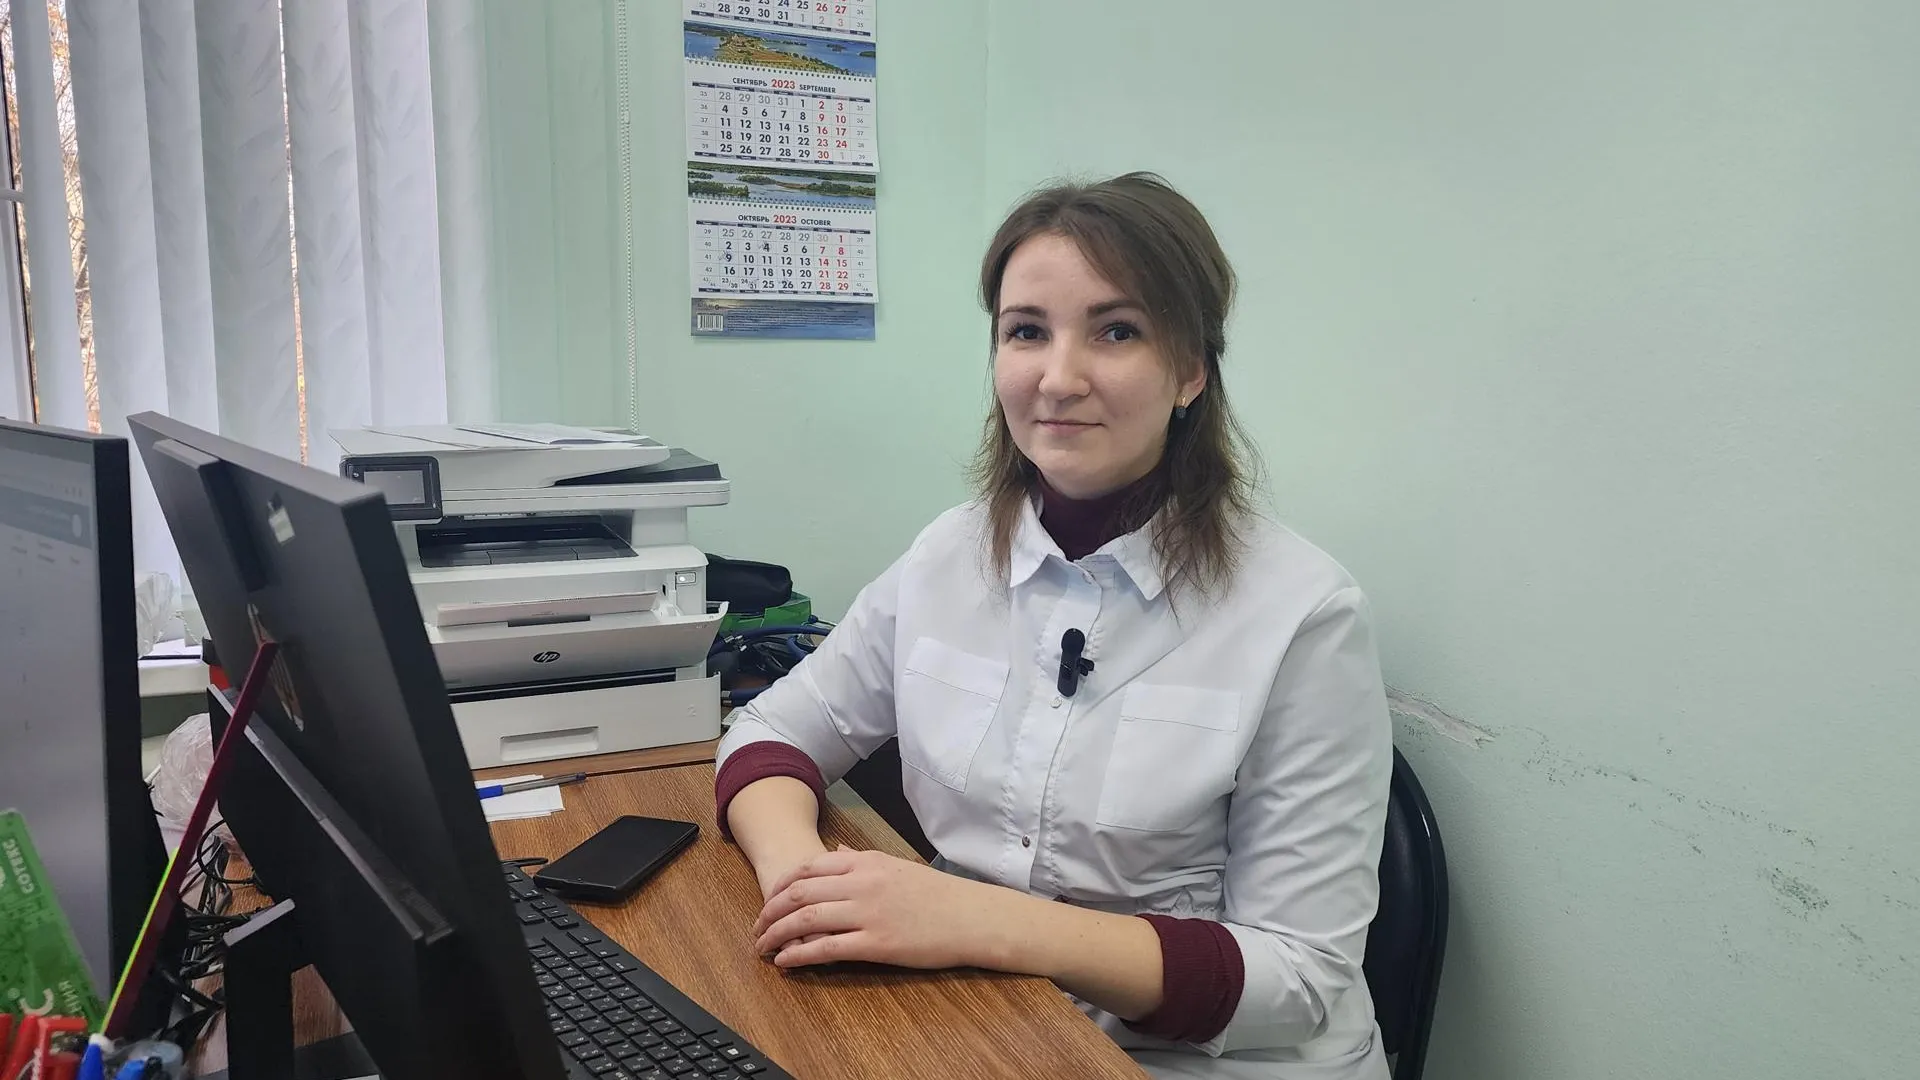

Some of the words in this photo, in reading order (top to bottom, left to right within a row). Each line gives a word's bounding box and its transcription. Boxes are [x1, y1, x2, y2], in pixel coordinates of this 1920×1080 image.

[797, 1, 809, 9] 25
[816, 3, 828, 12] 26
[835, 5, 847, 14] 27
[718, 3, 730, 13] 28
[738, 6, 750, 15] 29
[758, 8, 770, 18] 30
[778, 11, 789, 20] 31
[801, 13, 805, 22] 1
[819, 16, 825, 25] 2
[838, 18, 843, 27] 3
[733, 77, 767, 87] СЕНТЯБРЬ
[771, 79, 796, 89] 2023
[799, 83, 836, 93] SEPTEMBER
[719, 91, 731, 100] 28
[738, 93, 751, 103] 29
[758, 95, 770, 104] 30
[778, 96, 789, 106] 31
[800, 99, 805, 107] 1
[819, 101, 825, 109] 2
[837, 102, 843, 111] 3
[722, 105, 729, 113] 4
[742, 107, 748, 115] 5
[761, 108, 768, 117] 6
[781, 110, 787, 119] 7
[800, 111, 806, 120] 8
[819, 114, 825, 122] 9
[836, 115, 846, 124] 10
[720, 117, 731, 126] 11
[740, 119, 751, 128] 12
[759, 121, 771, 130] 13
[779, 123, 790, 131] 14
[798, 124, 809, 133] 15
[817, 126, 828, 135] 16
[836, 127, 847, 136] 17
[720, 130, 732, 140] 18
[740, 132, 752, 141] 19
[759, 134, 771, 143] 20
[778, 136, 790, 144] 21
[798, 137, 810, 146] 22
[817, 139, 829, 147] 23
[836, 140, 847, 148] 24
[720, 144, 733, 153] 25
[740, 145, 752, 154] 26
[759, 147, 771, 156] 27
[779, 148, 791, 157] 28
[798, 149, 810, 158] 29
[817, 151, 829, 159] 30
[840, 152, 844, 160] 1
[738, 215, 770, 223] ОКТЯБРЬ
[773, 215, 797, 224] 2023
[800, 218, 831, 226] OCTOBER
[722, 229, 734, 237] 25
[741, 230, 754, 238] 26
[761, 231, 772, 239] 27
[779, 232, 791, 241] 28
[798, 233, 810, 242] 29
[817, 234, 828, 242] 30
[839, 235, 843, 243] 1
[725, 242, 732, 250] 2
[745, 242, 751, 251] 3
[764, 243, 770, 252] 4
[782, 244, 789, 253] 5
[801, 245, 807, 254] 6
[820, 247, 825, 255] 7
[838, 247, 844, 255] 8
[725, 254, 732, 262] 9
[743, 255, 754, 264] 10
[762, 256, 772, 264] 11
[781, 257, 792, 265] 12
[800, 258, 811, 266] 13
[818, 258, 829, 267] 14
[837, 259, 847, 267] 15
[724, 266, 735, 275] 16
[744, 267, 754, 276] 17
[762, 268, 774, 276] 18
[782, 269, 792, 277] 19
[800, 270, 812, 278] 20
[837, 271, 848, 279] 22
[762, 280, 774, 289] 25
[782, 280, 794, 289] 26
[800, 281, 812, 290] 27
[819, 282, 831, 290] 28
[838, 282, 849, 291] 29
[534, 651, 560, 662] hp
[686, 703, 697, 717] 2
